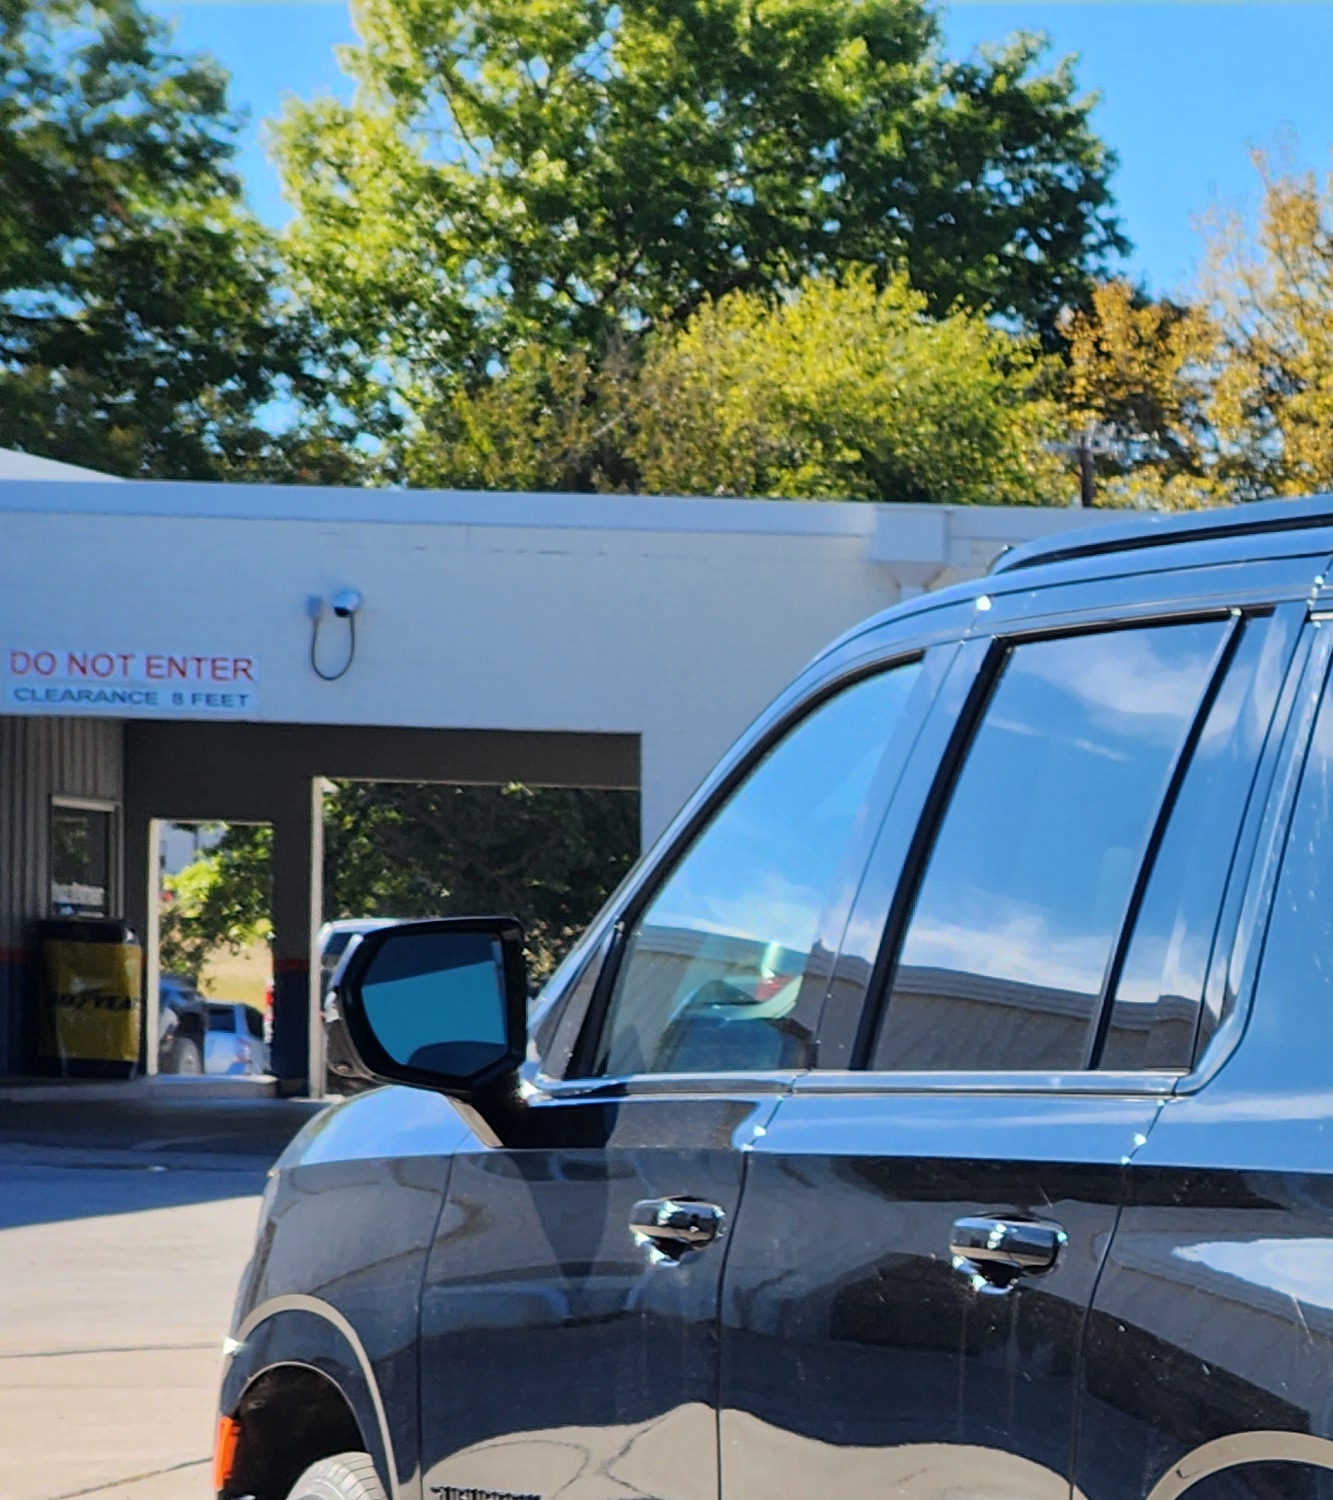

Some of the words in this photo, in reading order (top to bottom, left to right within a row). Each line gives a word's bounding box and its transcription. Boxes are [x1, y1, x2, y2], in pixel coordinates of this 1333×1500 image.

[10, 651, 57, 676] DO
[68, 652, 135, 678] NOT
[145, 654, 255, 682] ENTER
[13, 687, 158, 705] CLEARANCE
[172, 691, 184, 706] 8
[191, 692, 250, 708] FEET
